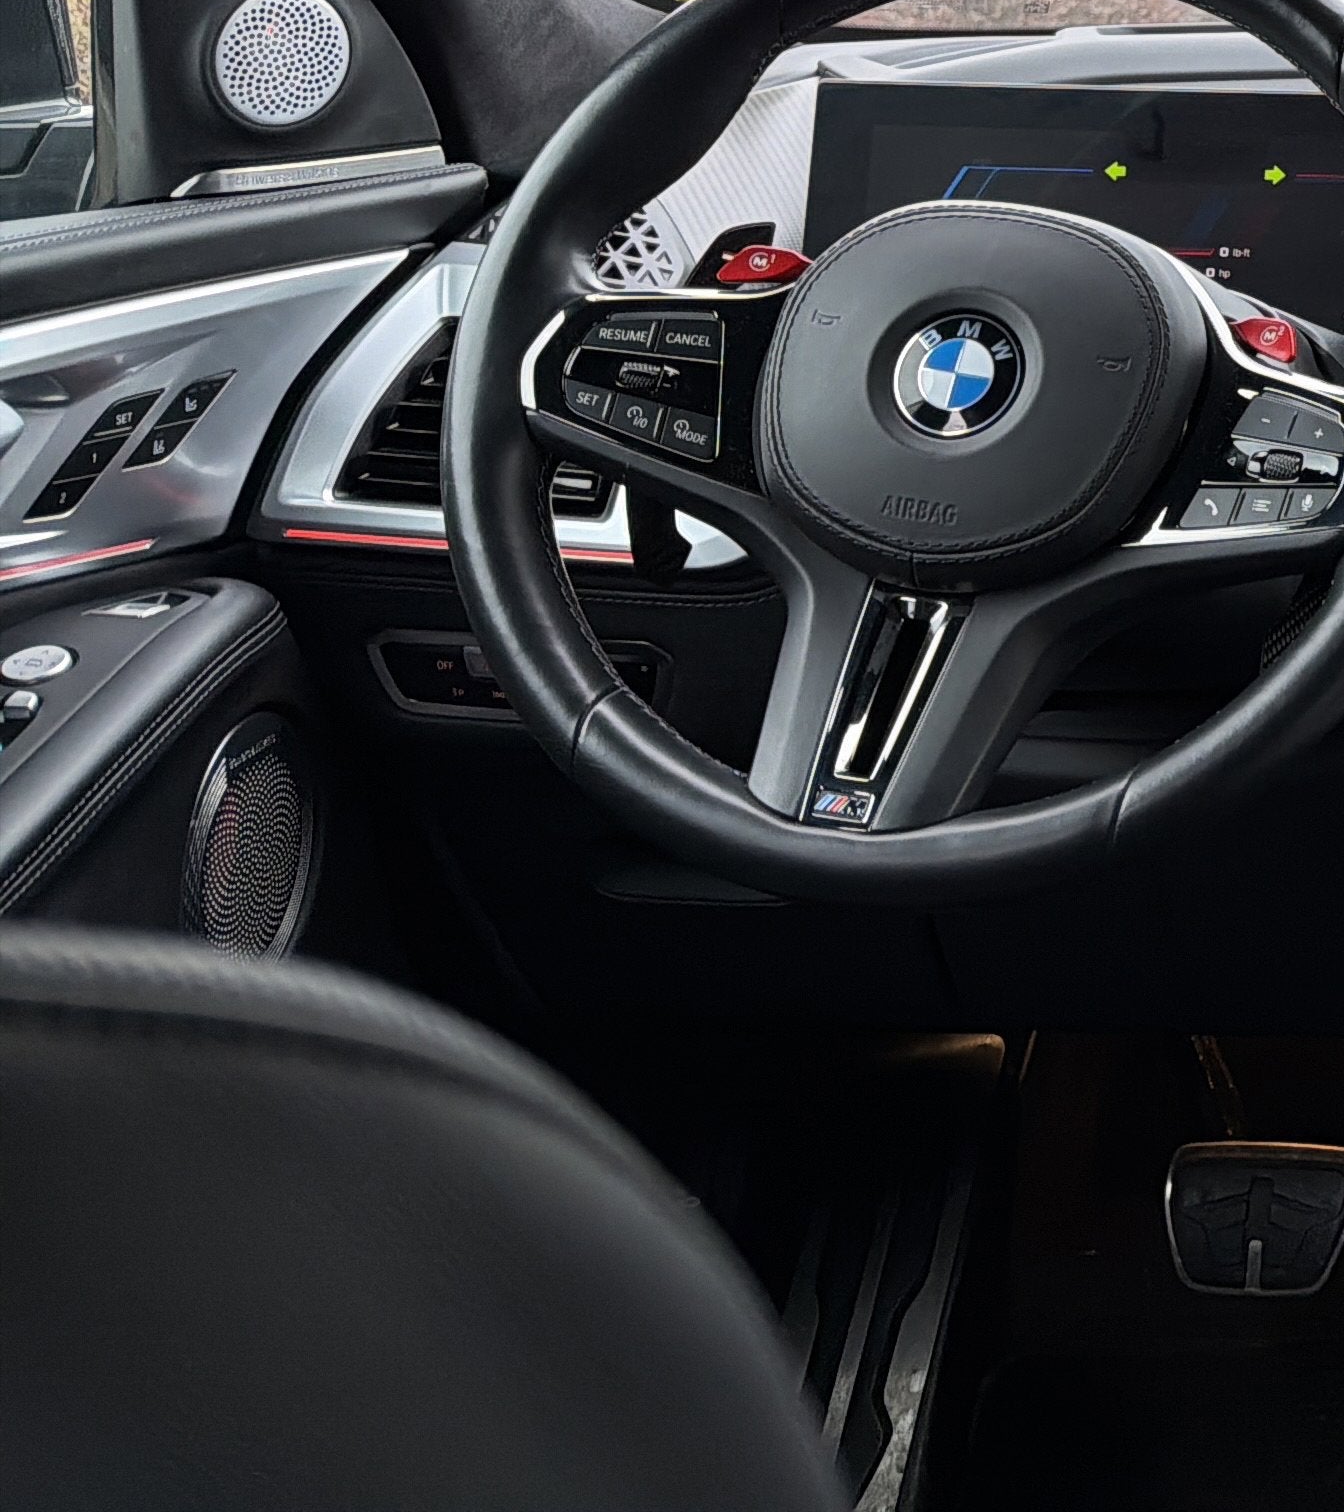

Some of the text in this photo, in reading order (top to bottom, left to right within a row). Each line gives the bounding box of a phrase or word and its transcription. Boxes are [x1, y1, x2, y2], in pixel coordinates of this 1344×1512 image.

[1219, 269, 1231, 279] hp
[599, 328, 711, 347] RESUME CANCEL
[918, 320, 1013, 361] BMW
[575, 391, 600, 406] SET
[115, 412, 133, 426] SET
[676, 429, 708, 445] MODE
[92, 453, 97, 464] 1
[59, 491, 67, 504] 2
[881, 495, 958, 526] AIRBAG
